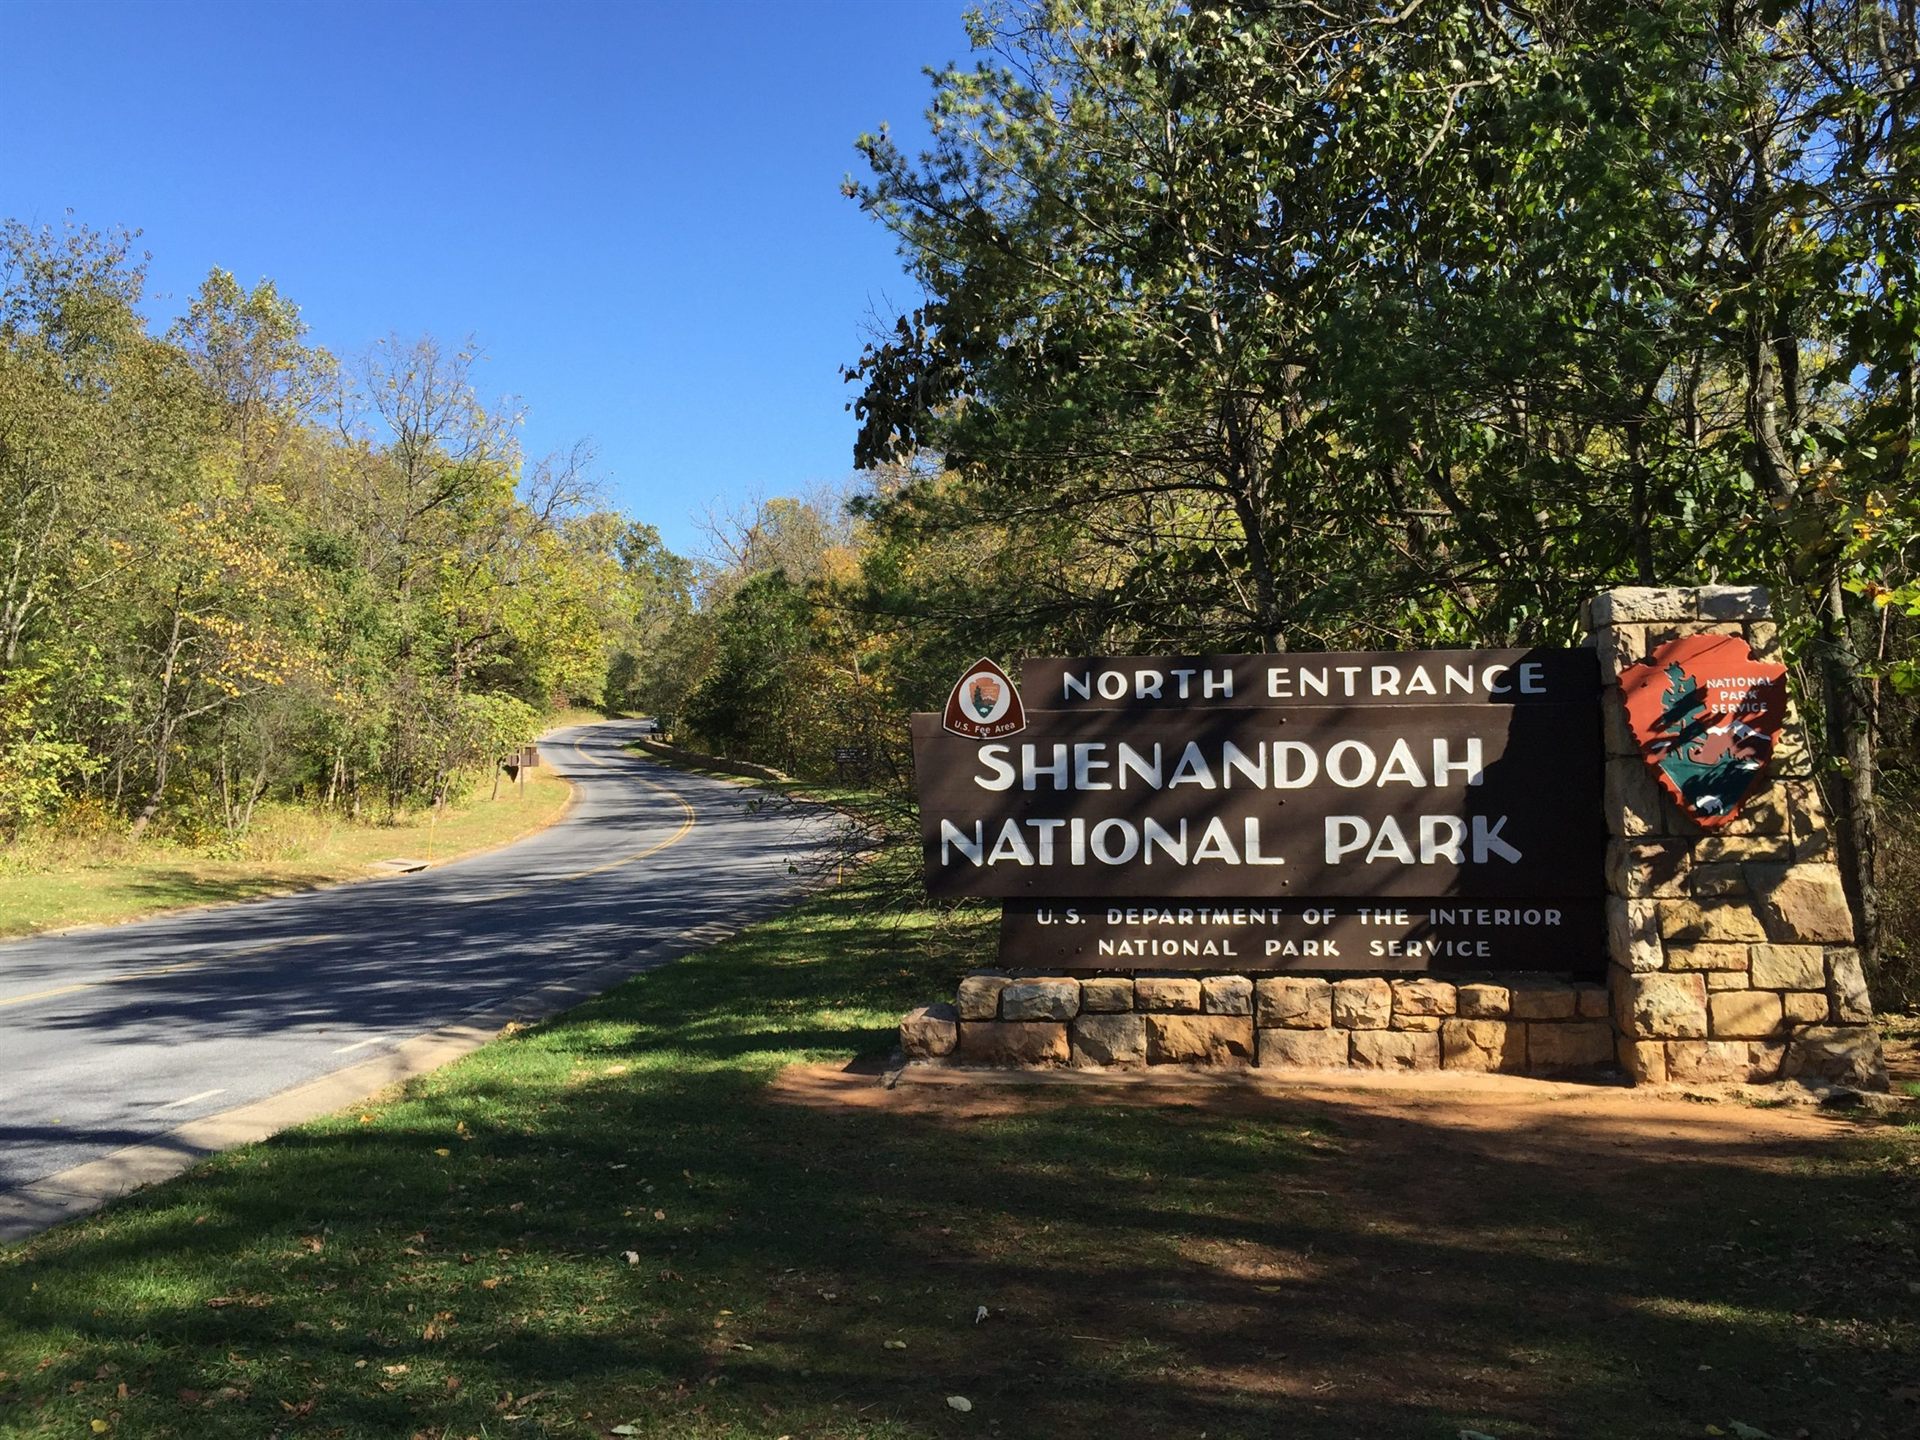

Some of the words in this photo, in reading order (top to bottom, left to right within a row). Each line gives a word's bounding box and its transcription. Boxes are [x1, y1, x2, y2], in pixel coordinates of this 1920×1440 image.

[1063, 668, 1233, 700] NORTH
[1267, 663, 1547, 698] ENTRANCE
[1706, 676, 1773, 688] NATIONAL
[1720, 690, 1757, 701] PARK
[1711, 702, 1768, 714] SERVICE
[954, 721, 970, 732] U.S.
[974, 725, 991, 734] Fee
[994, 722, 1015, 733] Area
[974, 737, 1484, 791] SHENANDOAH
[940, 816, 1285, 867] NATIONAL
[1325, 814, 1523, 864] PARK
[1107, 908, 1282, 925] DEPARTMENT
[1302, 908, 1337, 925] OF
[1357, 908, 1410, 925] THE
[1430, 908, 1562, 925] INTERIOR
[1098, 939, 1238, 956] NATIONAL
[1265, 939, 1341, 957] PARK
[1369, 939, 1491, 957] SERVICE
